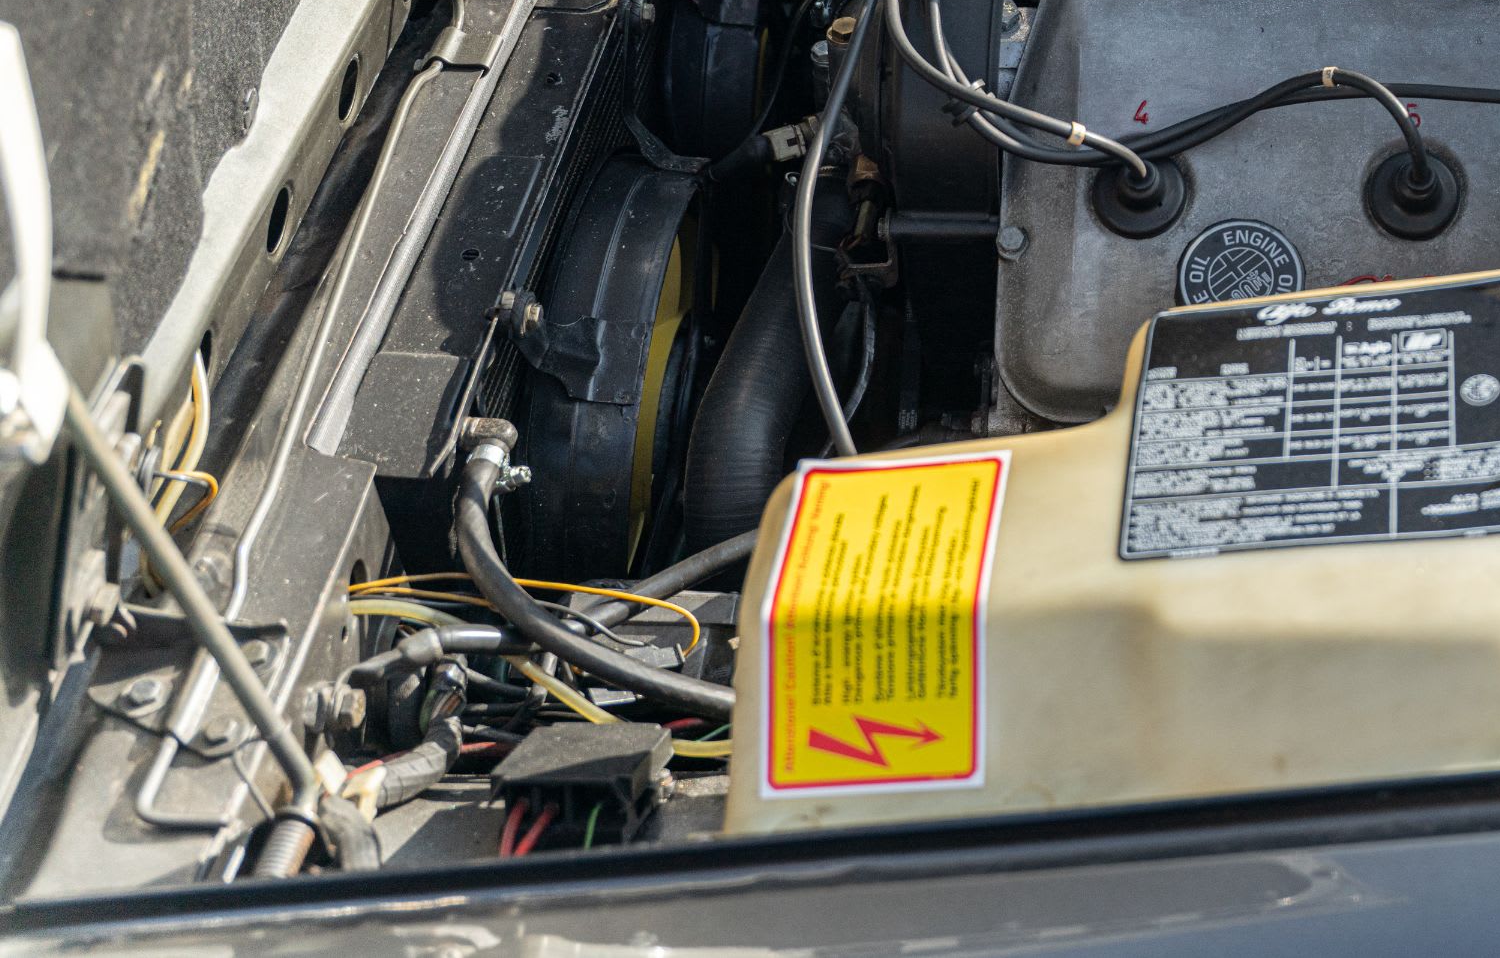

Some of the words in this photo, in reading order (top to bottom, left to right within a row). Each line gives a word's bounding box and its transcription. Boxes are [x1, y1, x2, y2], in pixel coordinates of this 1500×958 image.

[1134, 100, 1149, 124] 4
[1189, 256, 1211, 283] OIL
[1222, 229, 1290, 268] ENGINE
